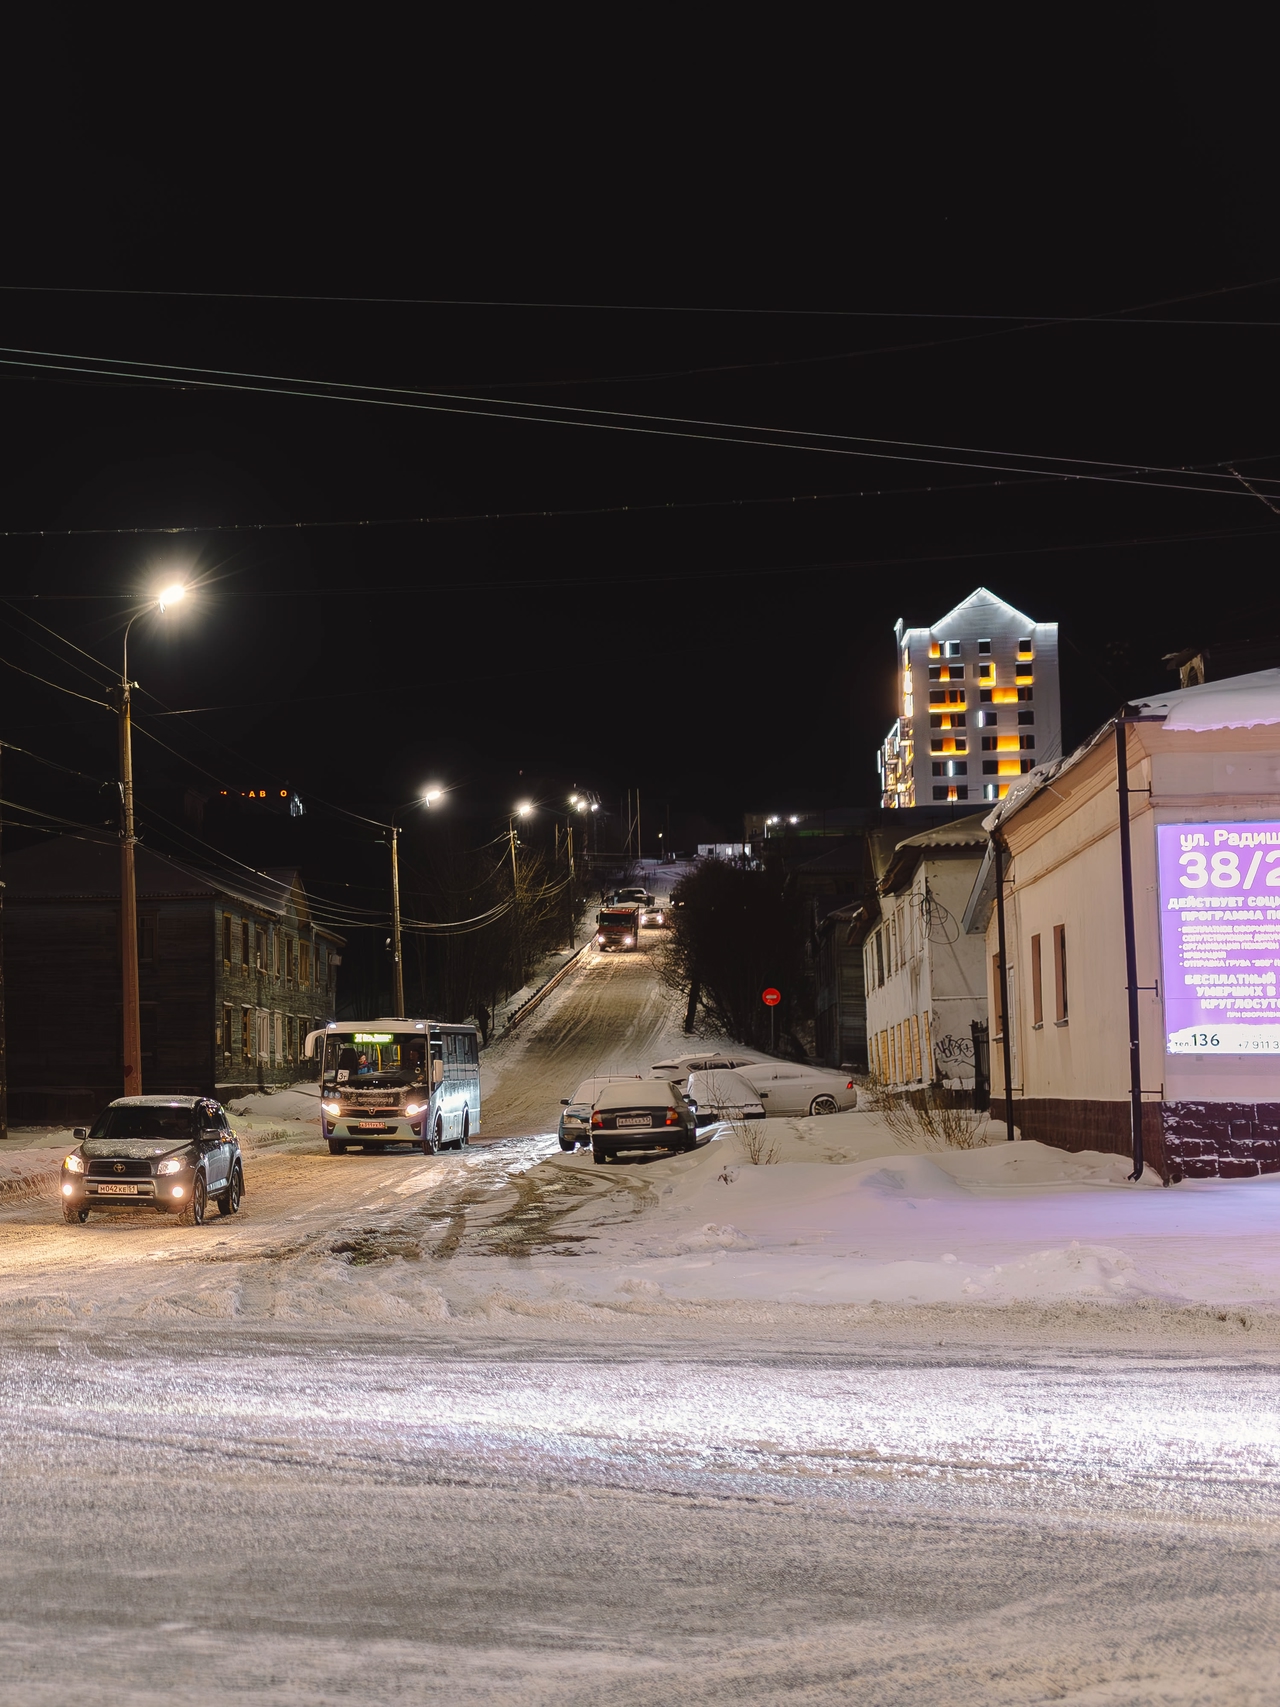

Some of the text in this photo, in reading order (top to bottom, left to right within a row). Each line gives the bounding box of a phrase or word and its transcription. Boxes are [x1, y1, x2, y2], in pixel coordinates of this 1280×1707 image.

[1180, 834, 1210, 852] ул.
[1168, 895, 1245, 910] ДЕЙСТВУЕТ
[1181, 911, 1264, 921] ПРОГРАММА
[1184, 972, 1276, 985] БЕСПЛАТНЫЙ
[1196, 986, 1276, 997] УМЕРШИХ В
[1191, 1033, 1220, 1046] 136
